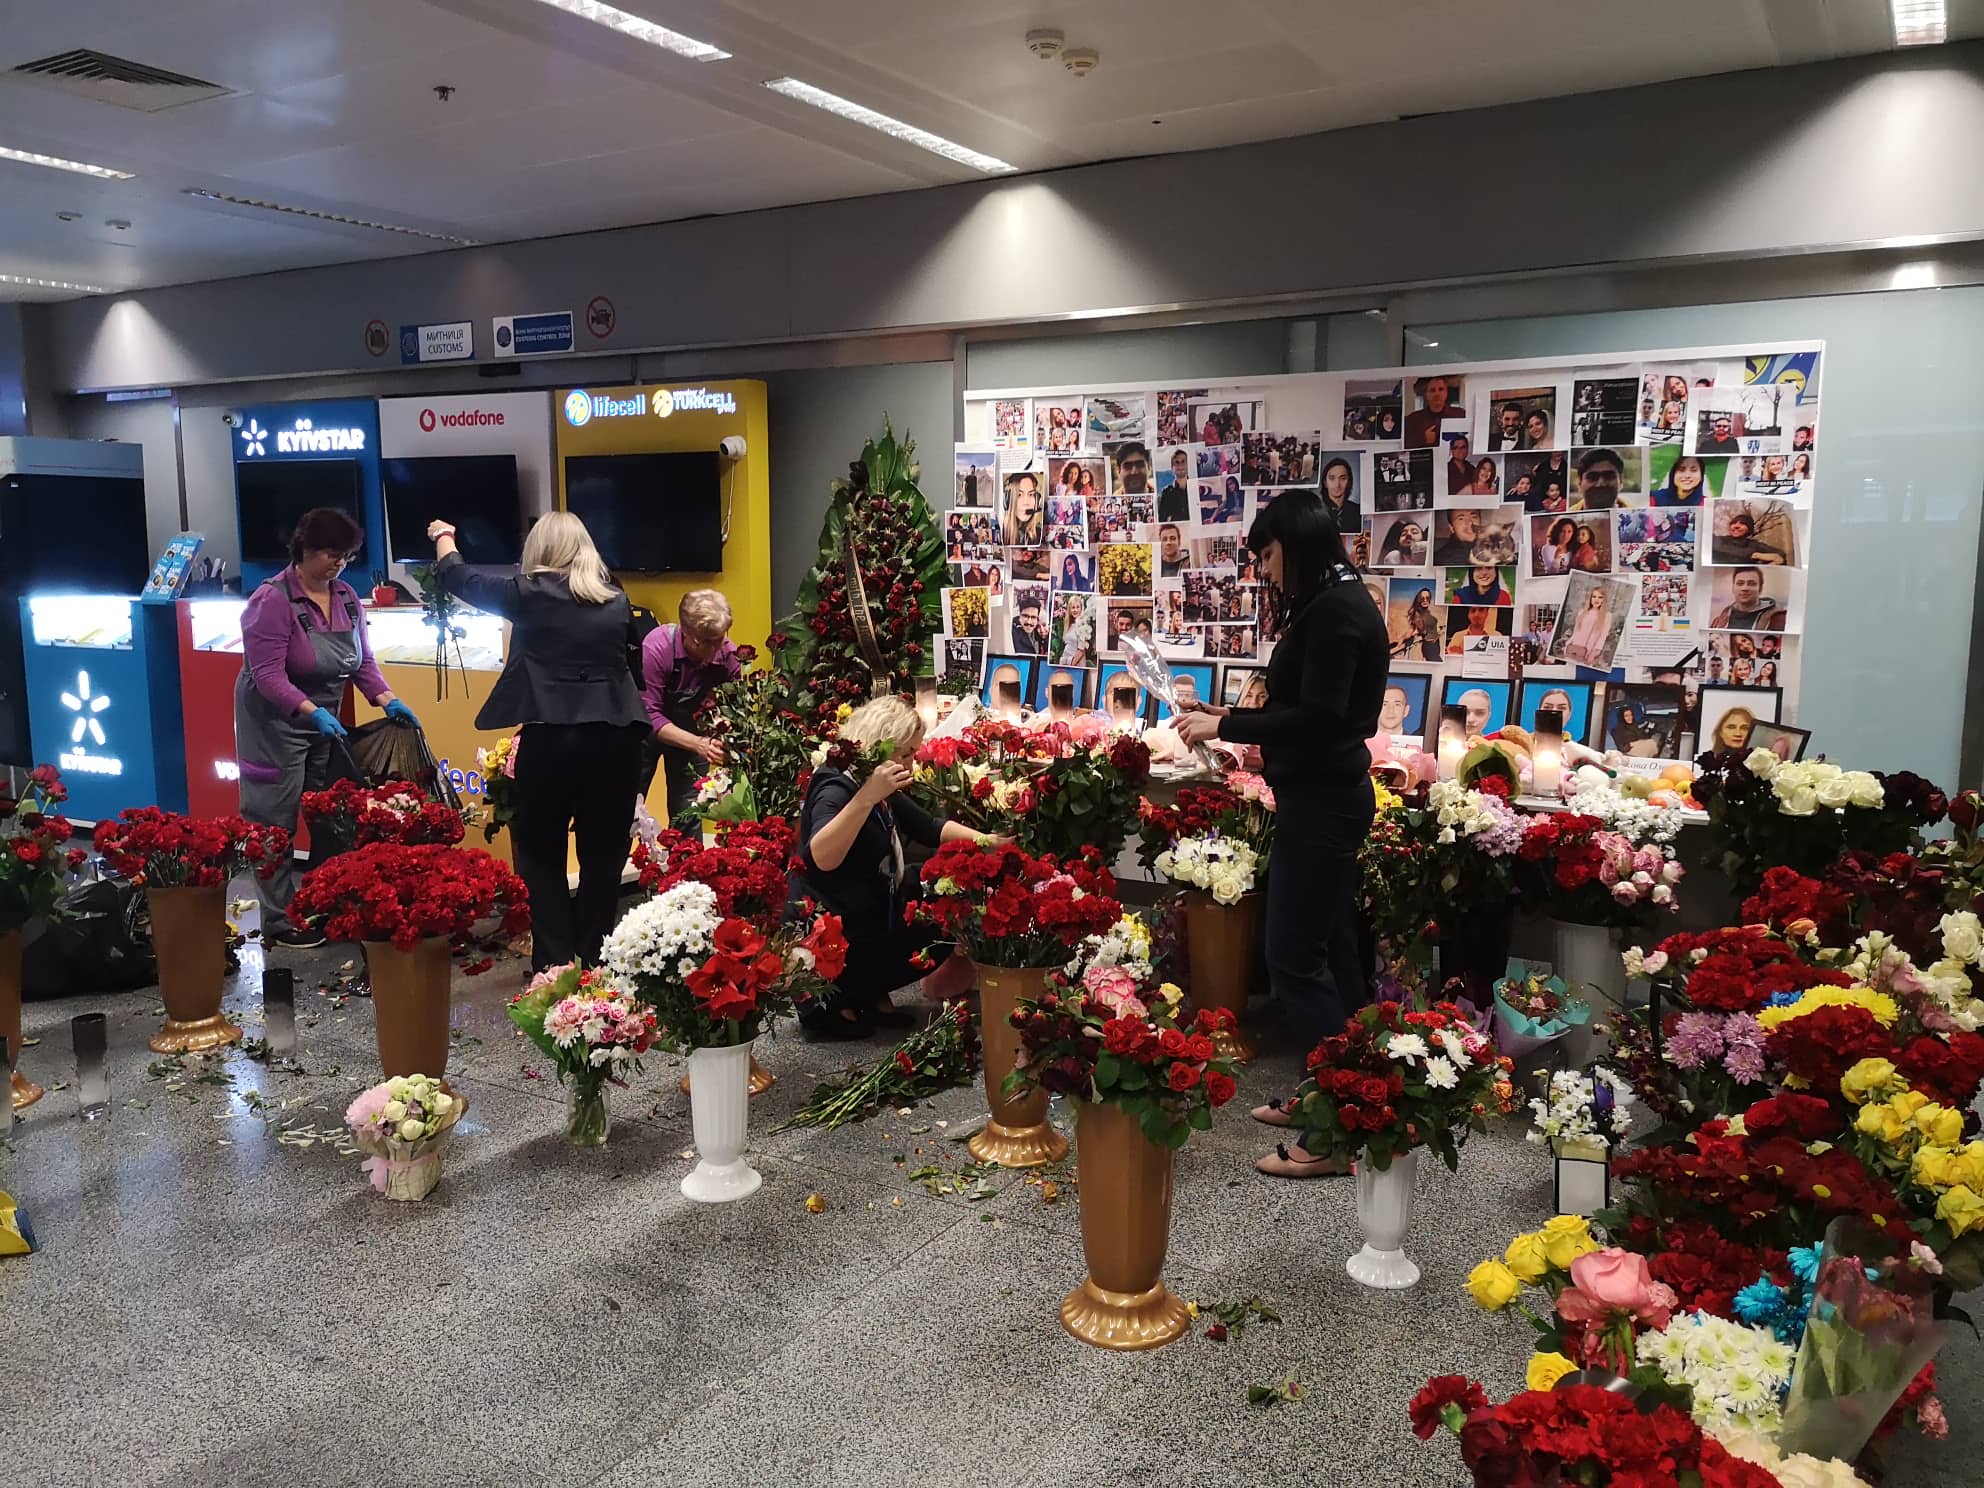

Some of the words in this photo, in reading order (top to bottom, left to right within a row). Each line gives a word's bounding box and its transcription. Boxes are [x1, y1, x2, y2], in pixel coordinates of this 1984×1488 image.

[426, 329, 464, 341] МИТНИЦЯ
[428, 342, 464, 353] CUSTOMS
[592, 394, 646, 417] lifecell
[440, 409, 505, 427] vodafone
[1491, 641, 1504, 649] UIA
